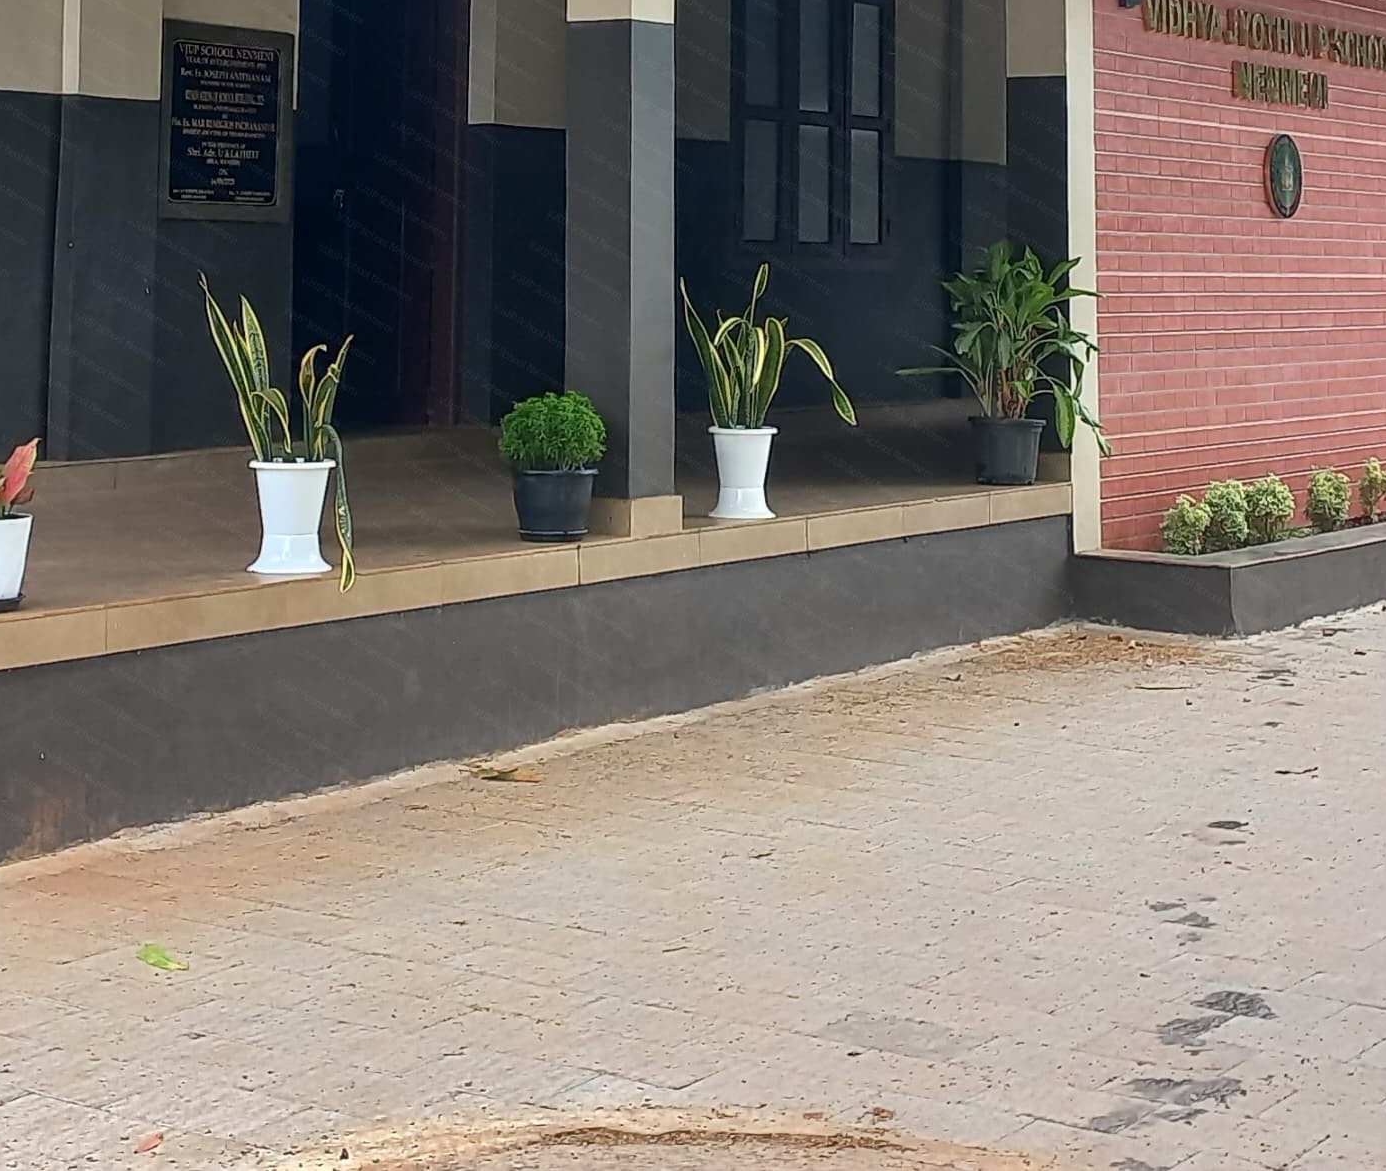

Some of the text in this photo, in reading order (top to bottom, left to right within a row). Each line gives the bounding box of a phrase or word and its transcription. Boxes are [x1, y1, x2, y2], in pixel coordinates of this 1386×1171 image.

[179, 42, 199, 56] VJUP
[201, 45, 234, 59] SCHOOL
[1295, 22, 1312, 57] U
[1313, 24, 1329, 59] P
